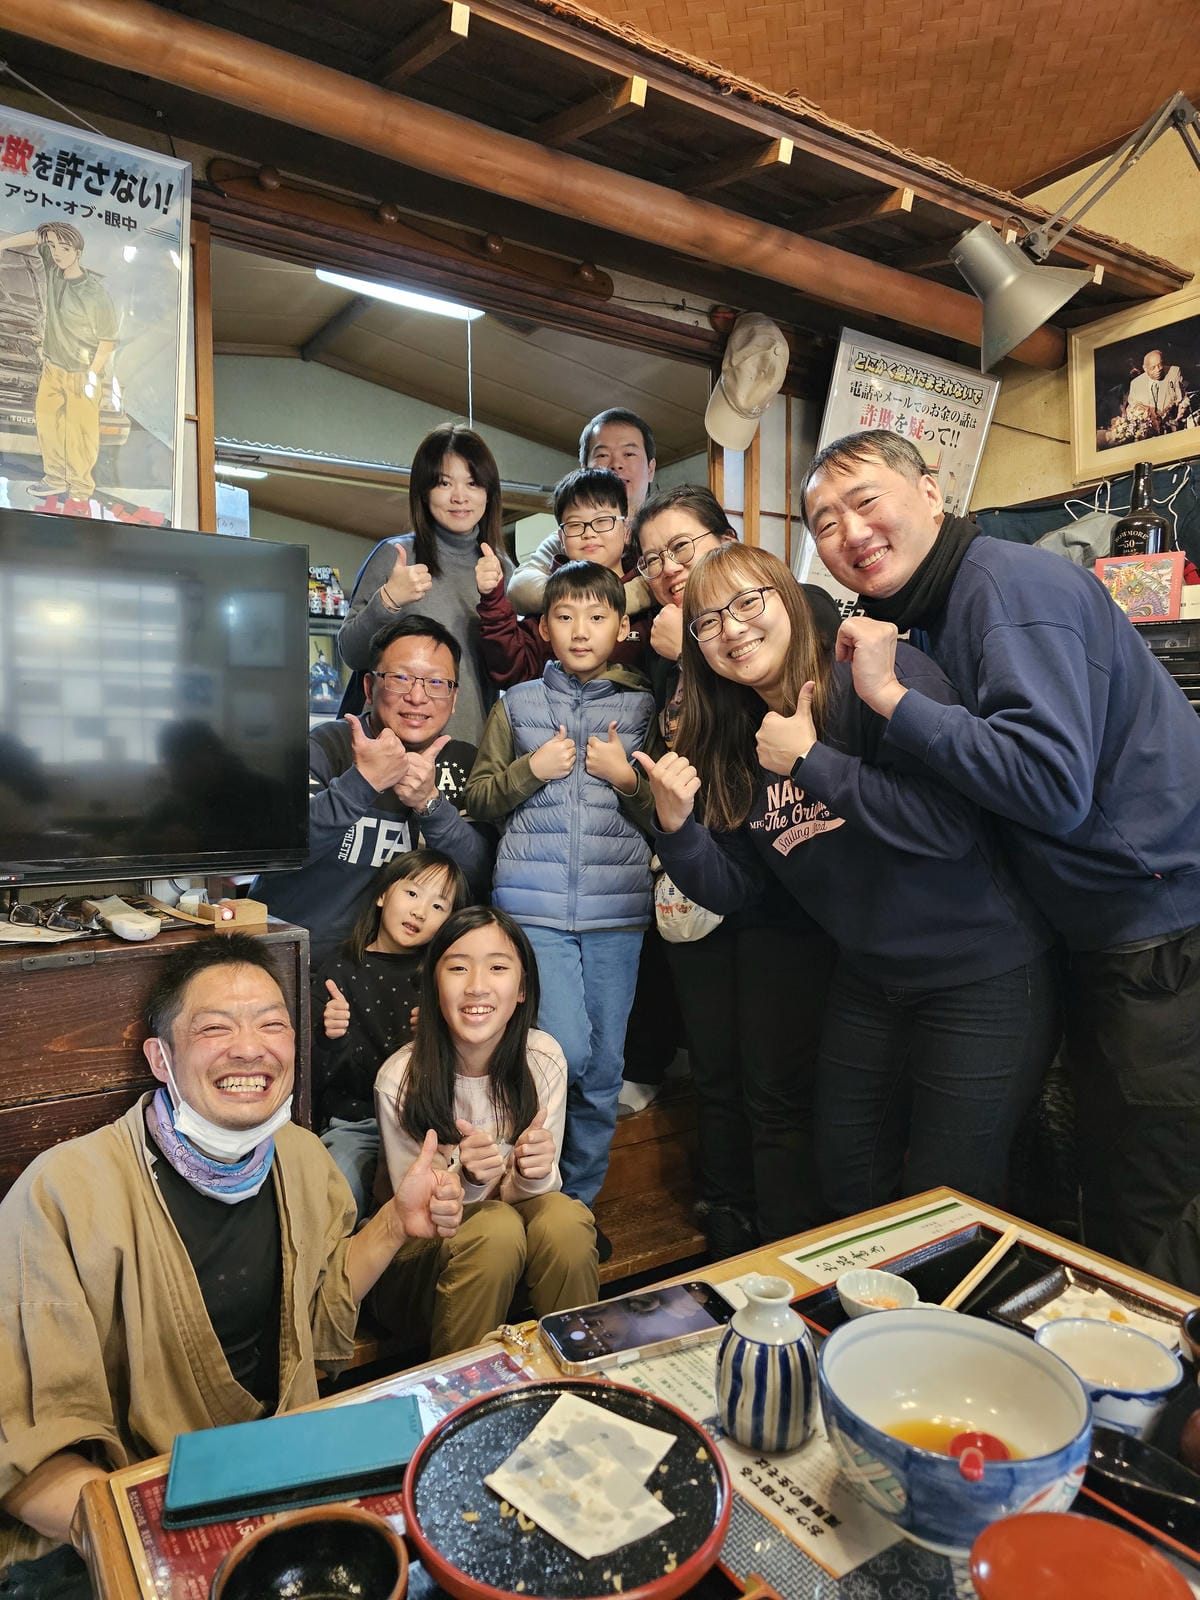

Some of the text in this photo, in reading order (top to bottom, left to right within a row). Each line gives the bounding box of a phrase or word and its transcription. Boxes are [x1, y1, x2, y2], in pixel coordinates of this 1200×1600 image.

[0, 134, 174, 215] 欺を許さない!
[4, 182, 138, 232] アウト・オブ・眼中
[854, 352, 984, 405] とにかく絶対だまされないで
[850, 380, 977, 429] 電話やメールでのお金の話は
[437, 767, 457, 791] A
[765, 809, 788, 832] The
[779, 826, 809, 852] Sailing
